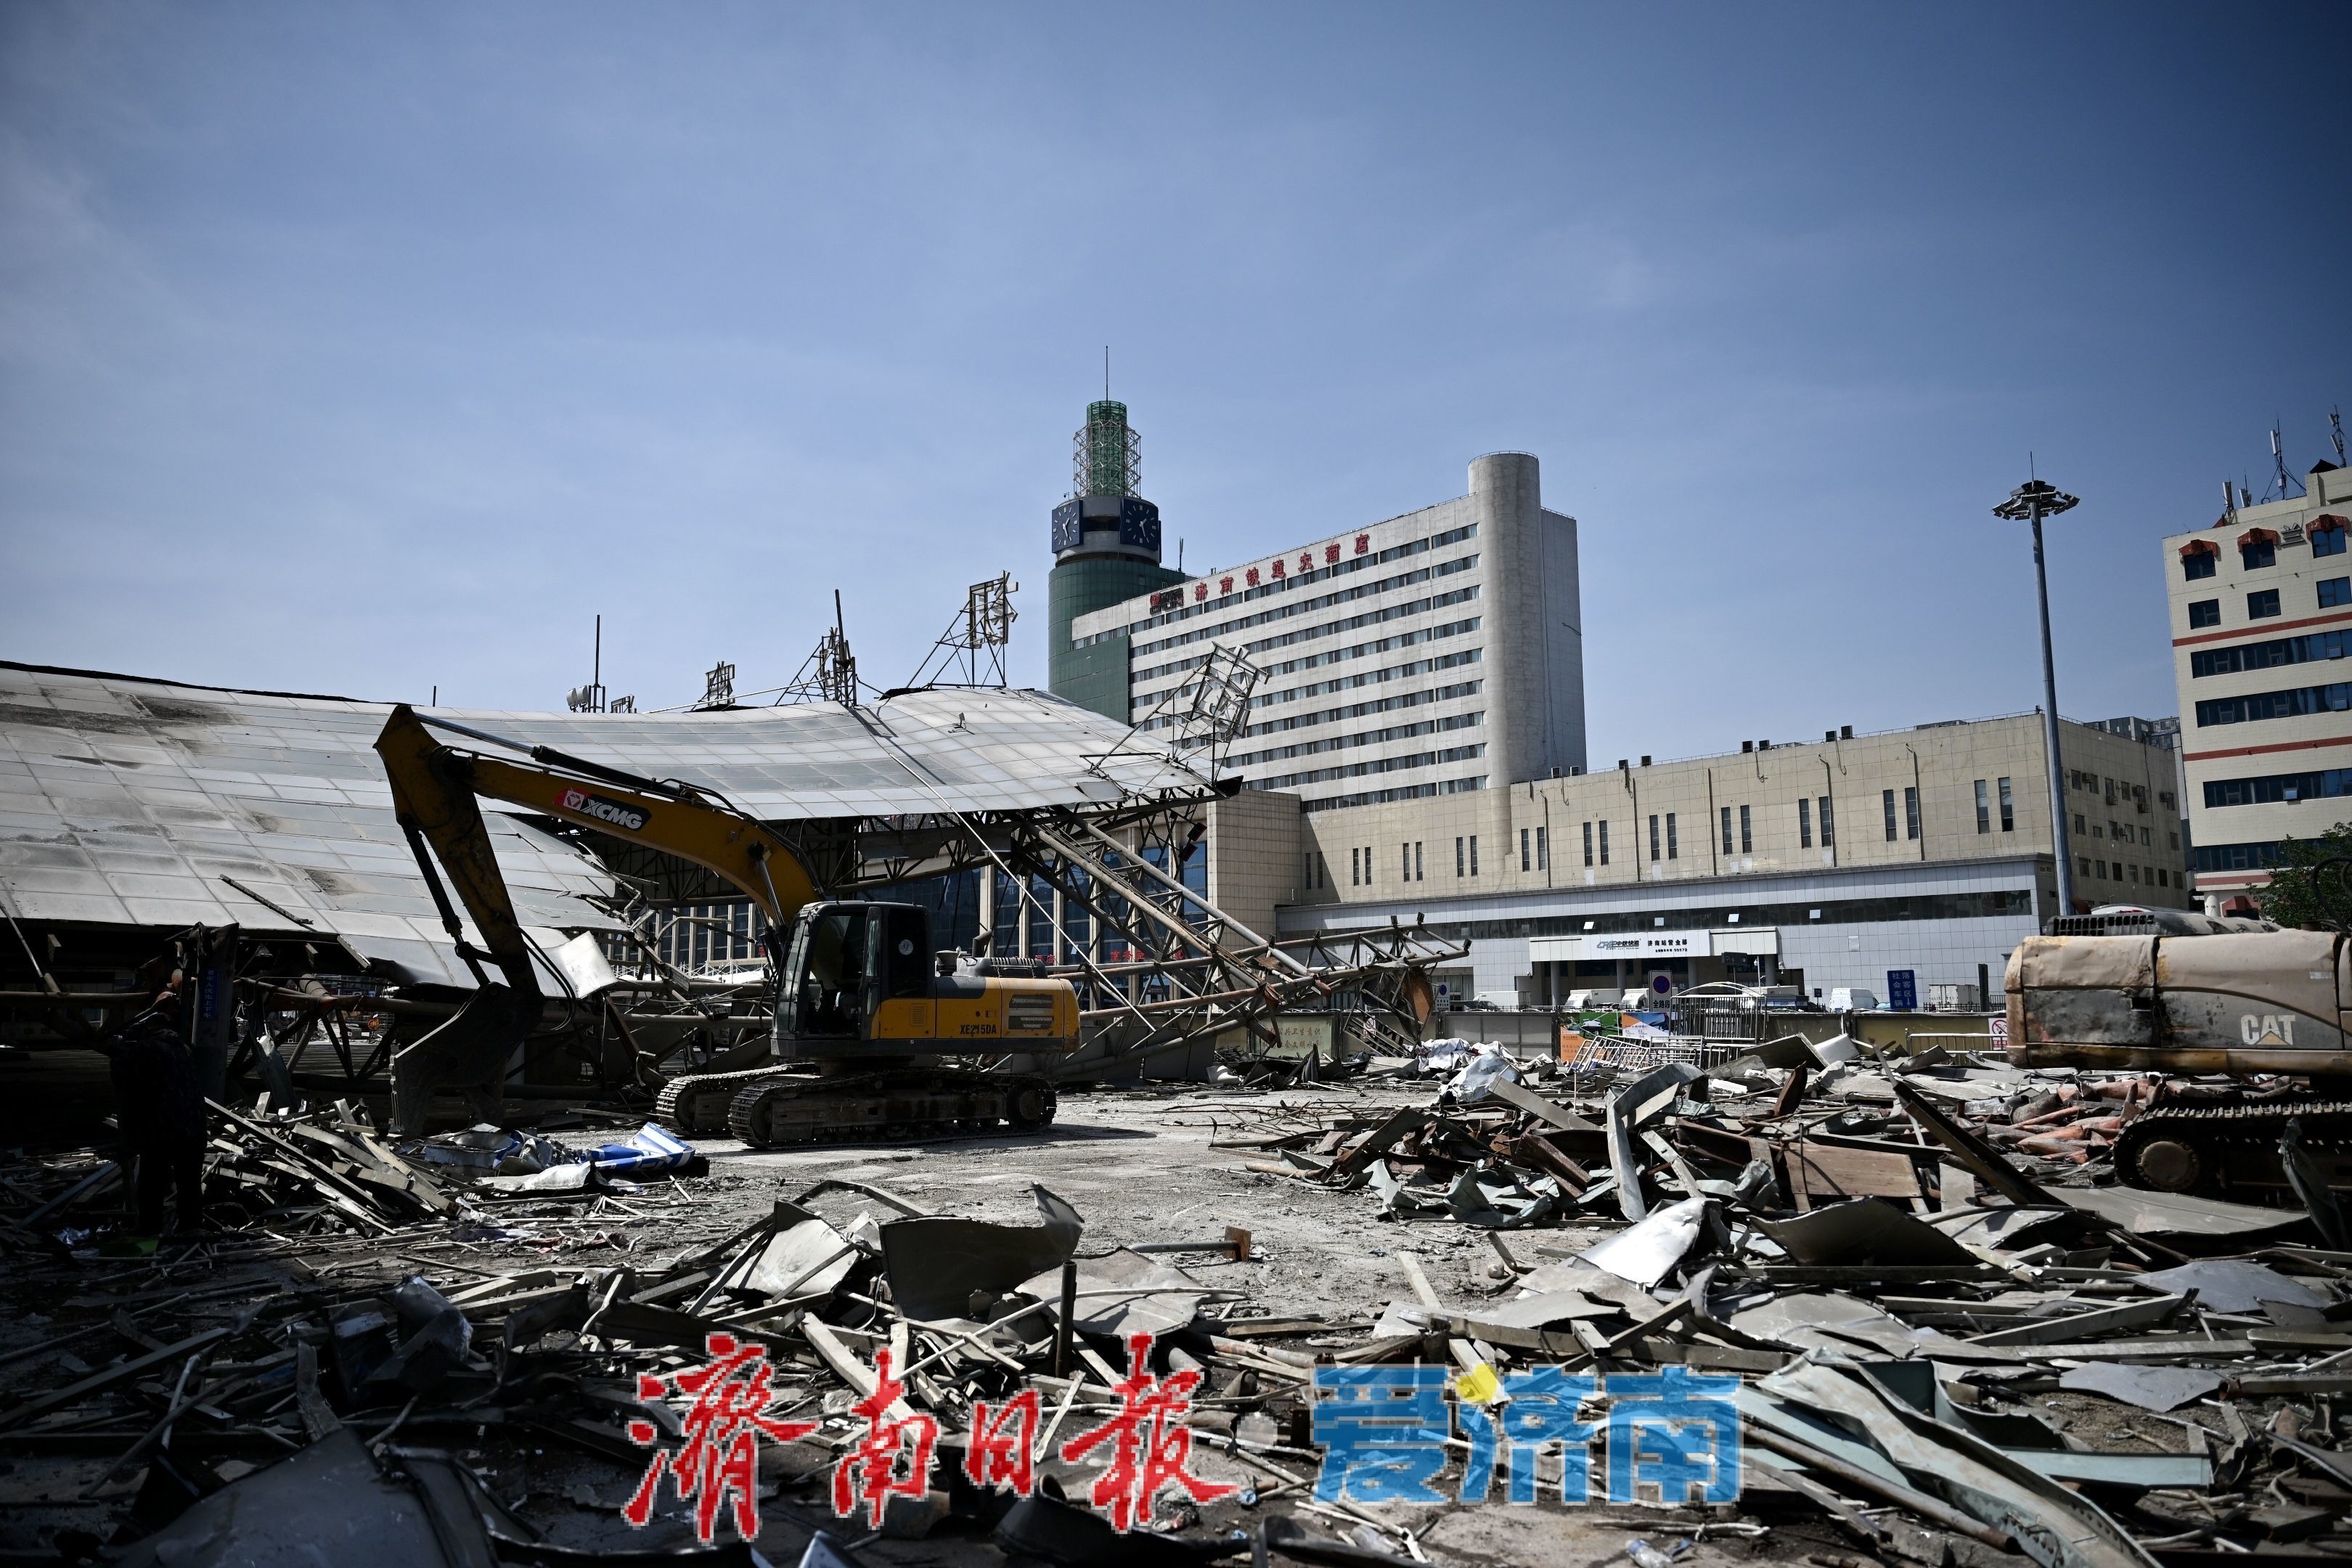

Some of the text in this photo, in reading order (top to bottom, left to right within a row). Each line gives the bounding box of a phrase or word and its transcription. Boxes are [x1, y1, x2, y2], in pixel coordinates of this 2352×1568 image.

[1194, 534, 1371, 602] 济南铁道大酒店
[580, 799, 642, 830] XCMG
[1892, 973, 1903, 1007] 社会车辆
[1902, 971, 1912, 997] 落客区
[1653, 1000, 1670, 1008] 全路段
[960, 1024, 997, 1034] XE215DA
[2240, 1014, 2296, 1045] CAT
